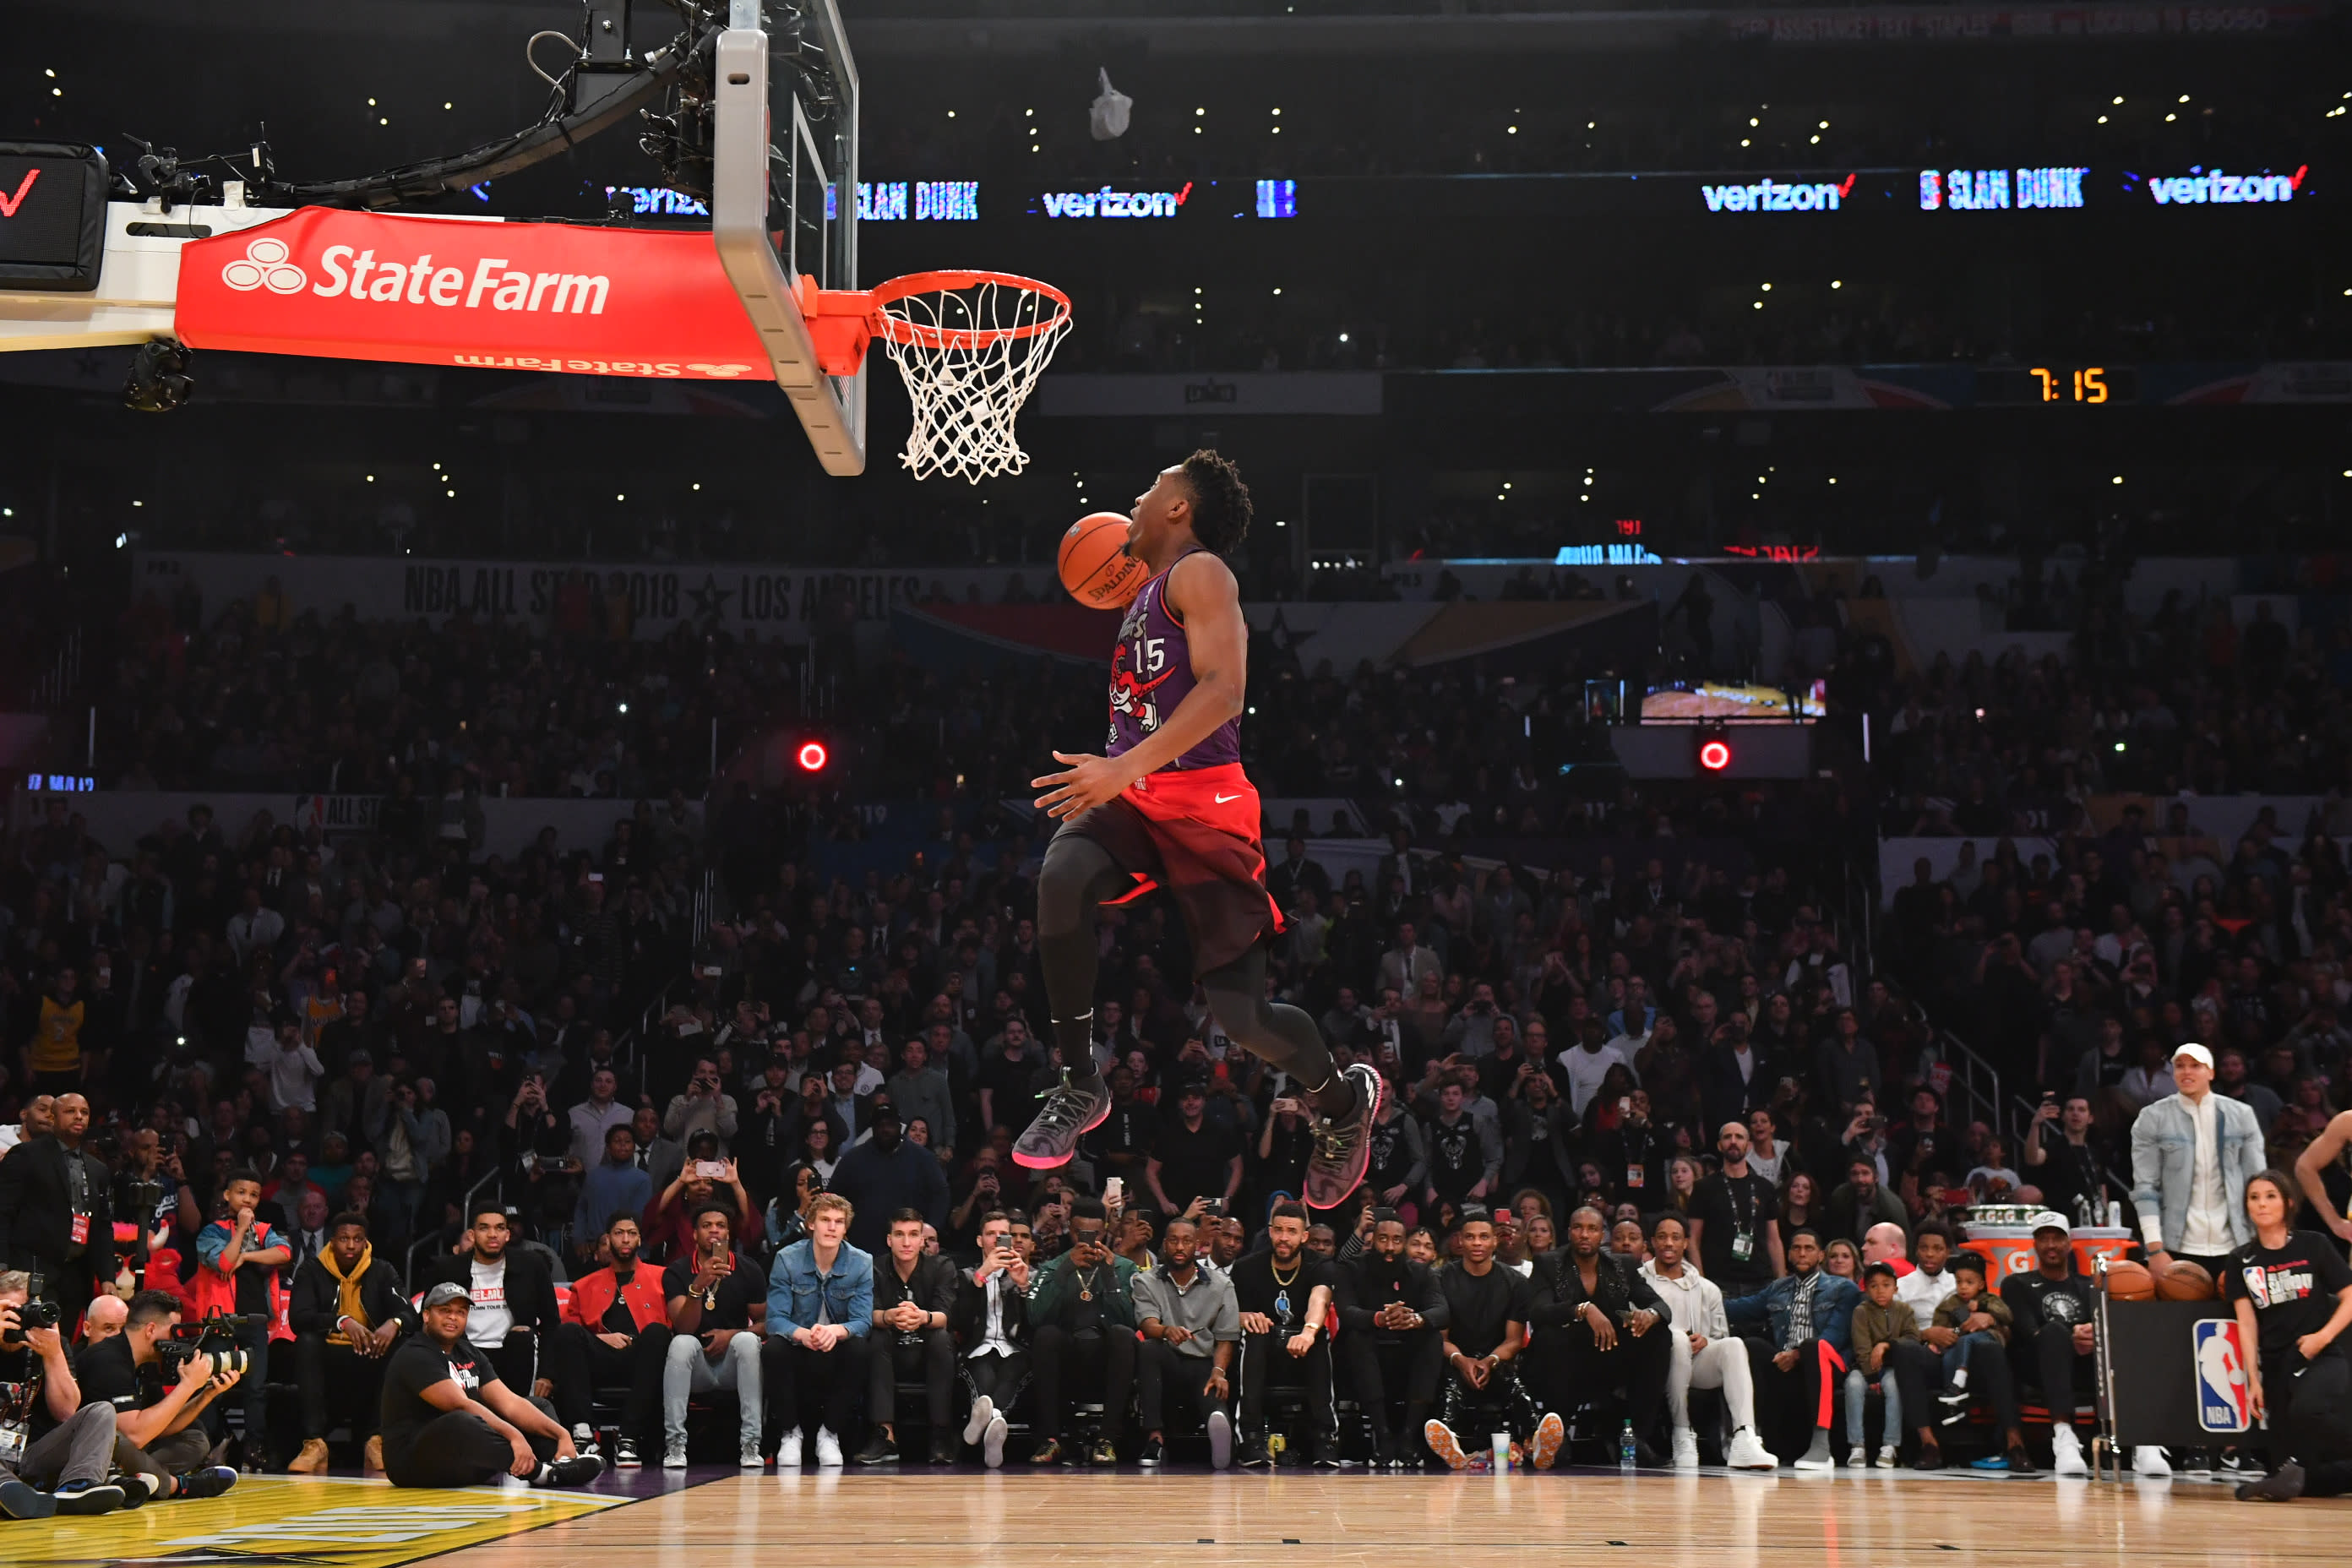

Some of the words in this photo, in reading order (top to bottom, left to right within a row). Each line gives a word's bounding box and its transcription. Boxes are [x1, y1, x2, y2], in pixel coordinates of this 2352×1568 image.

[916, 181, 978, 220] DUNK
[1043, 185, 1178, 217] verizon
[1701, 178, 1840, 211] verizon
[1947, 170, 2010, 210] SLAM
[2017, 168, 2084, 208] DUNK
[2148, 168, 2292, 204] verizon
[405, 565, 461, 614] NBA
[471, 569, 523, 616] ALL
[741, 574, 790, 620] LOS
[1133, 637, 1166, 674] 15
[326, 797, 354, 825] ALL
[2205, 1405, 2233, 1425] NBA
